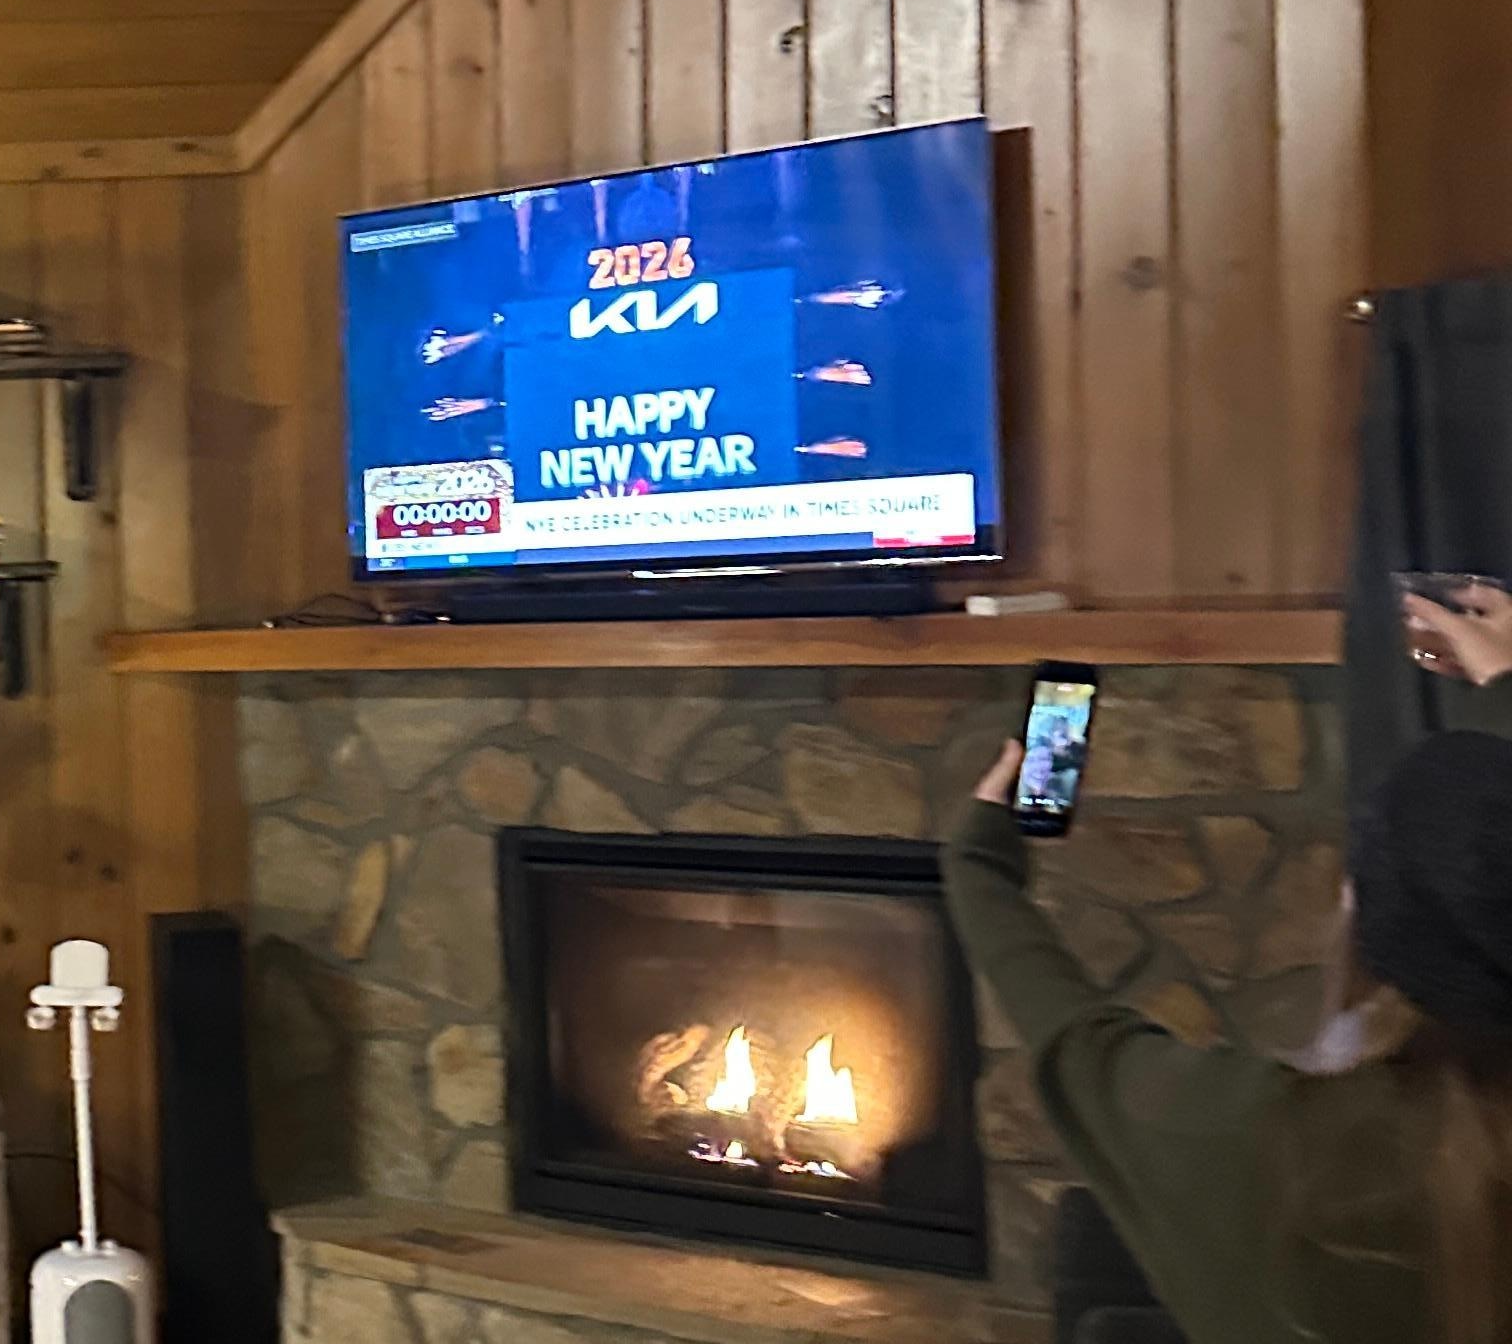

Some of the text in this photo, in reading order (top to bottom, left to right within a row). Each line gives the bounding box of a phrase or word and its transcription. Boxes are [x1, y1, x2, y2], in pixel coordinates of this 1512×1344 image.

[588, 237, 695, 290] 2026
[574, 387, 716, 441] HAPPY
[436, 467, 496, 496] 2026
[540, 434, 758, 488] NEW YEAR
[392, 500, 493, 527] 00:00:00
